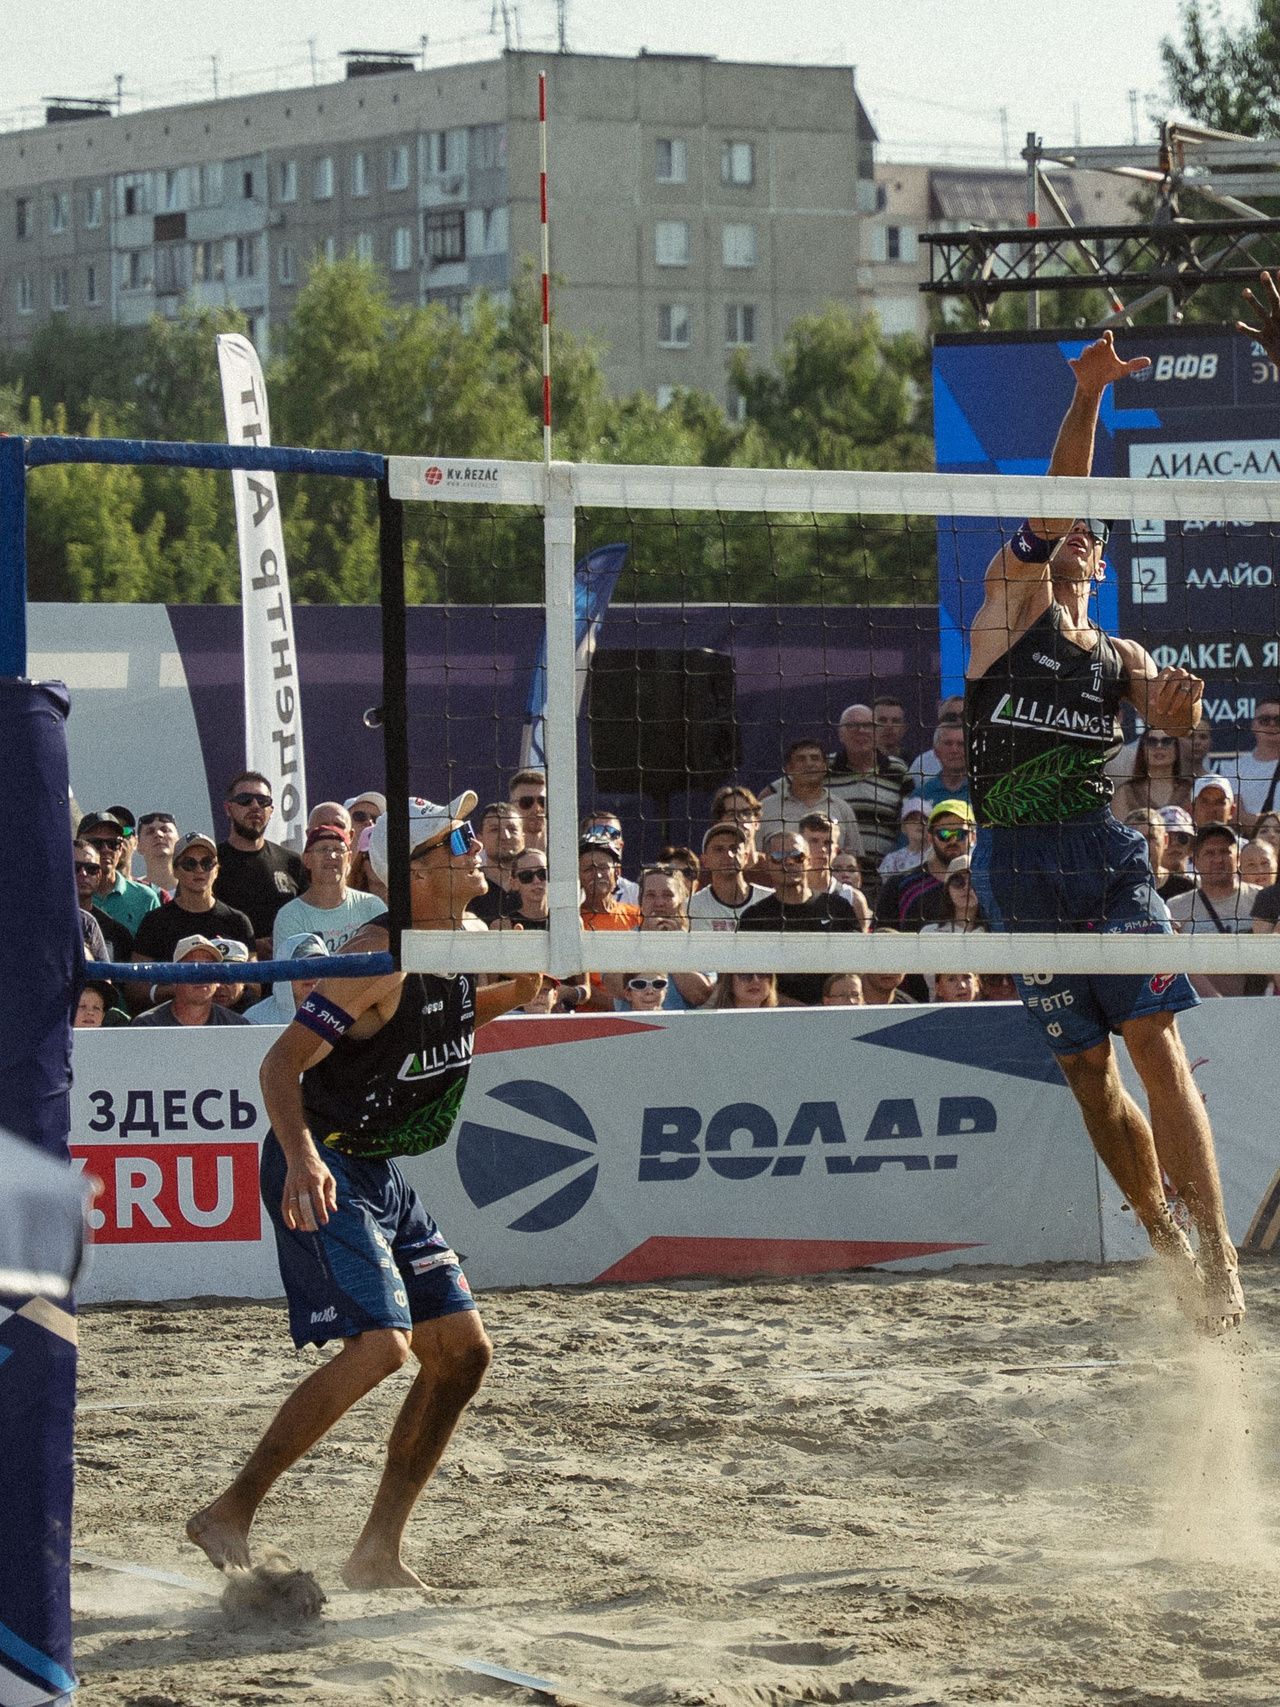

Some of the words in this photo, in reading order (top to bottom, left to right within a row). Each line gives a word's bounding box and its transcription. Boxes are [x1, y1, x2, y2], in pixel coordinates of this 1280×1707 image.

[1154, 353, 1219, 381] ВФВ
[1141, 569, 1158, 592] 2
[1185, 562, 1272, 589] АЛАЙО
[1151, 643, 1254, 669] ФАКЕЛ
[990, 693, 1112, 735] ALLIANCE
[1202, 697, 1257, 724] УДЯ
[1041, 990, 1075, 1012] ВТБ
[398, 1031, 475, 1076] ALLIAN
[89, 1089, 258, 1138] ЗДЕСЬ
[638, 1096, 998, 1182] ВОЛАР
